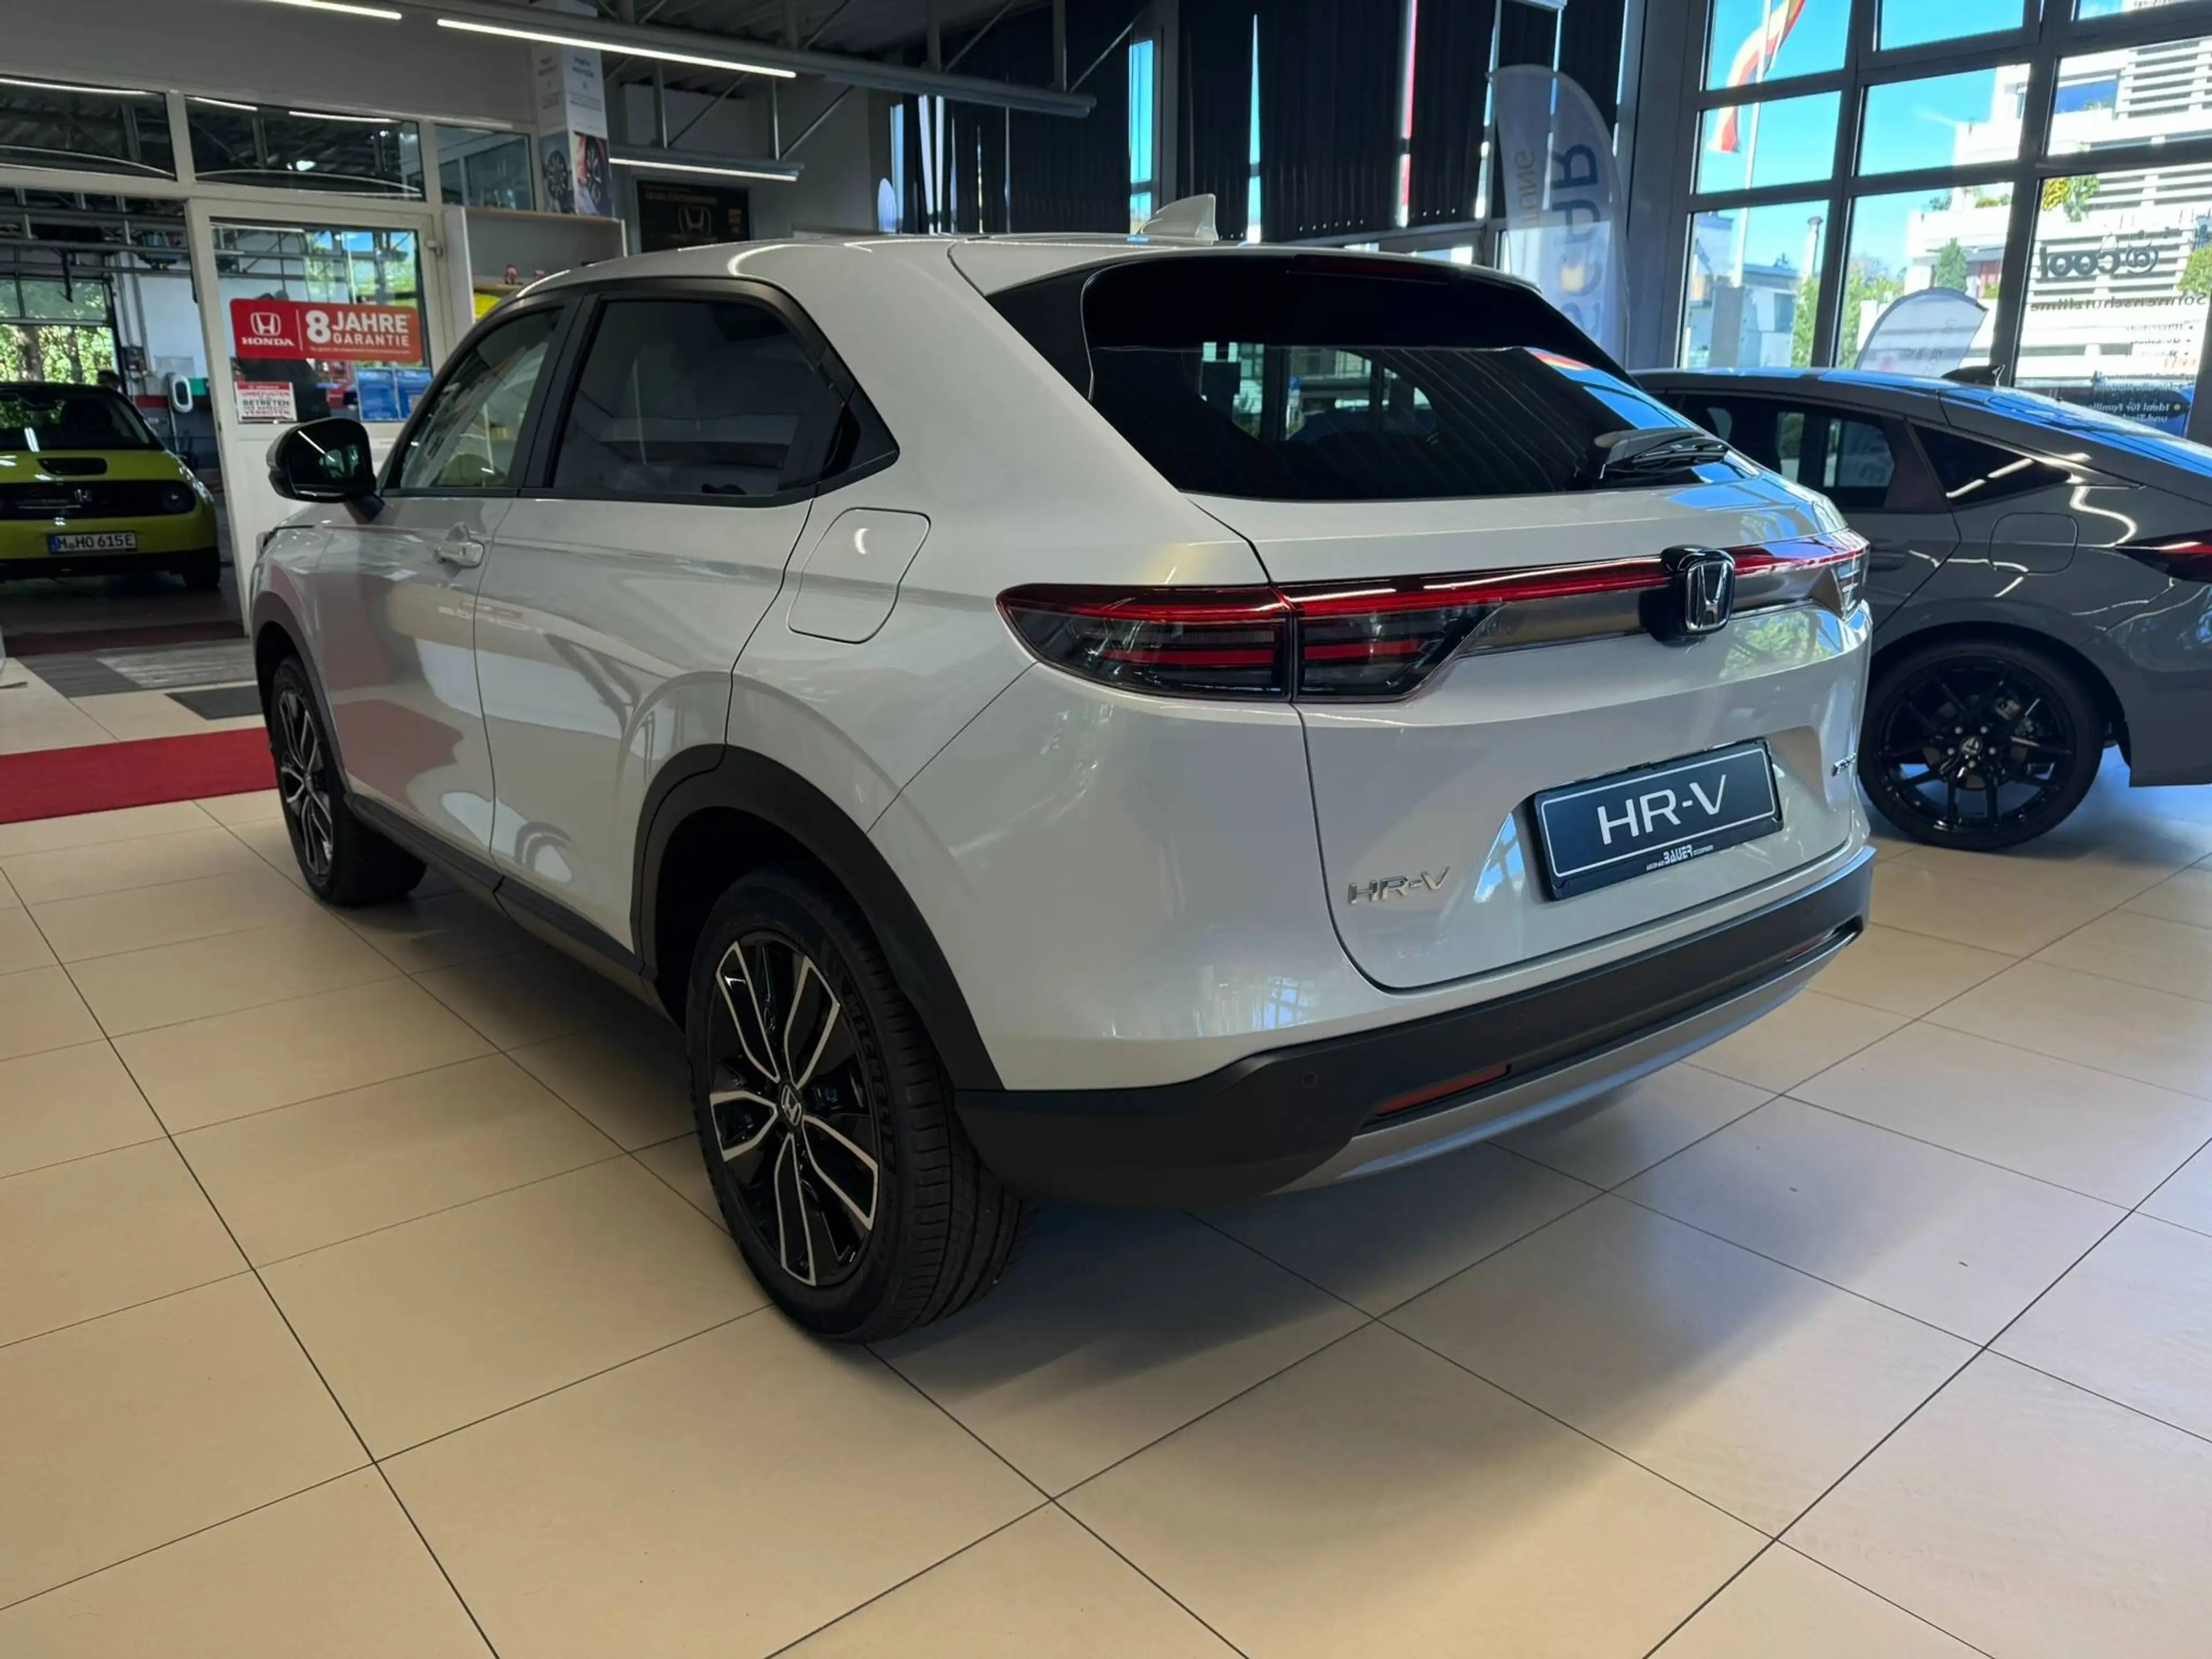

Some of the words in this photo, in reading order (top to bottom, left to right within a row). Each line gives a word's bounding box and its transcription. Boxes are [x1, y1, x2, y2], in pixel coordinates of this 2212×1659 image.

[305, 309, 331, 344] 8
[332, 333, 410, 346] GARANTIE
[241, 337, 296, 346] HONDA
[1597, 774, 1726, 845] HR-V
[1663, 844, 1693, 865] BAUER
[1348, 866, 1450, 904] HR-V
